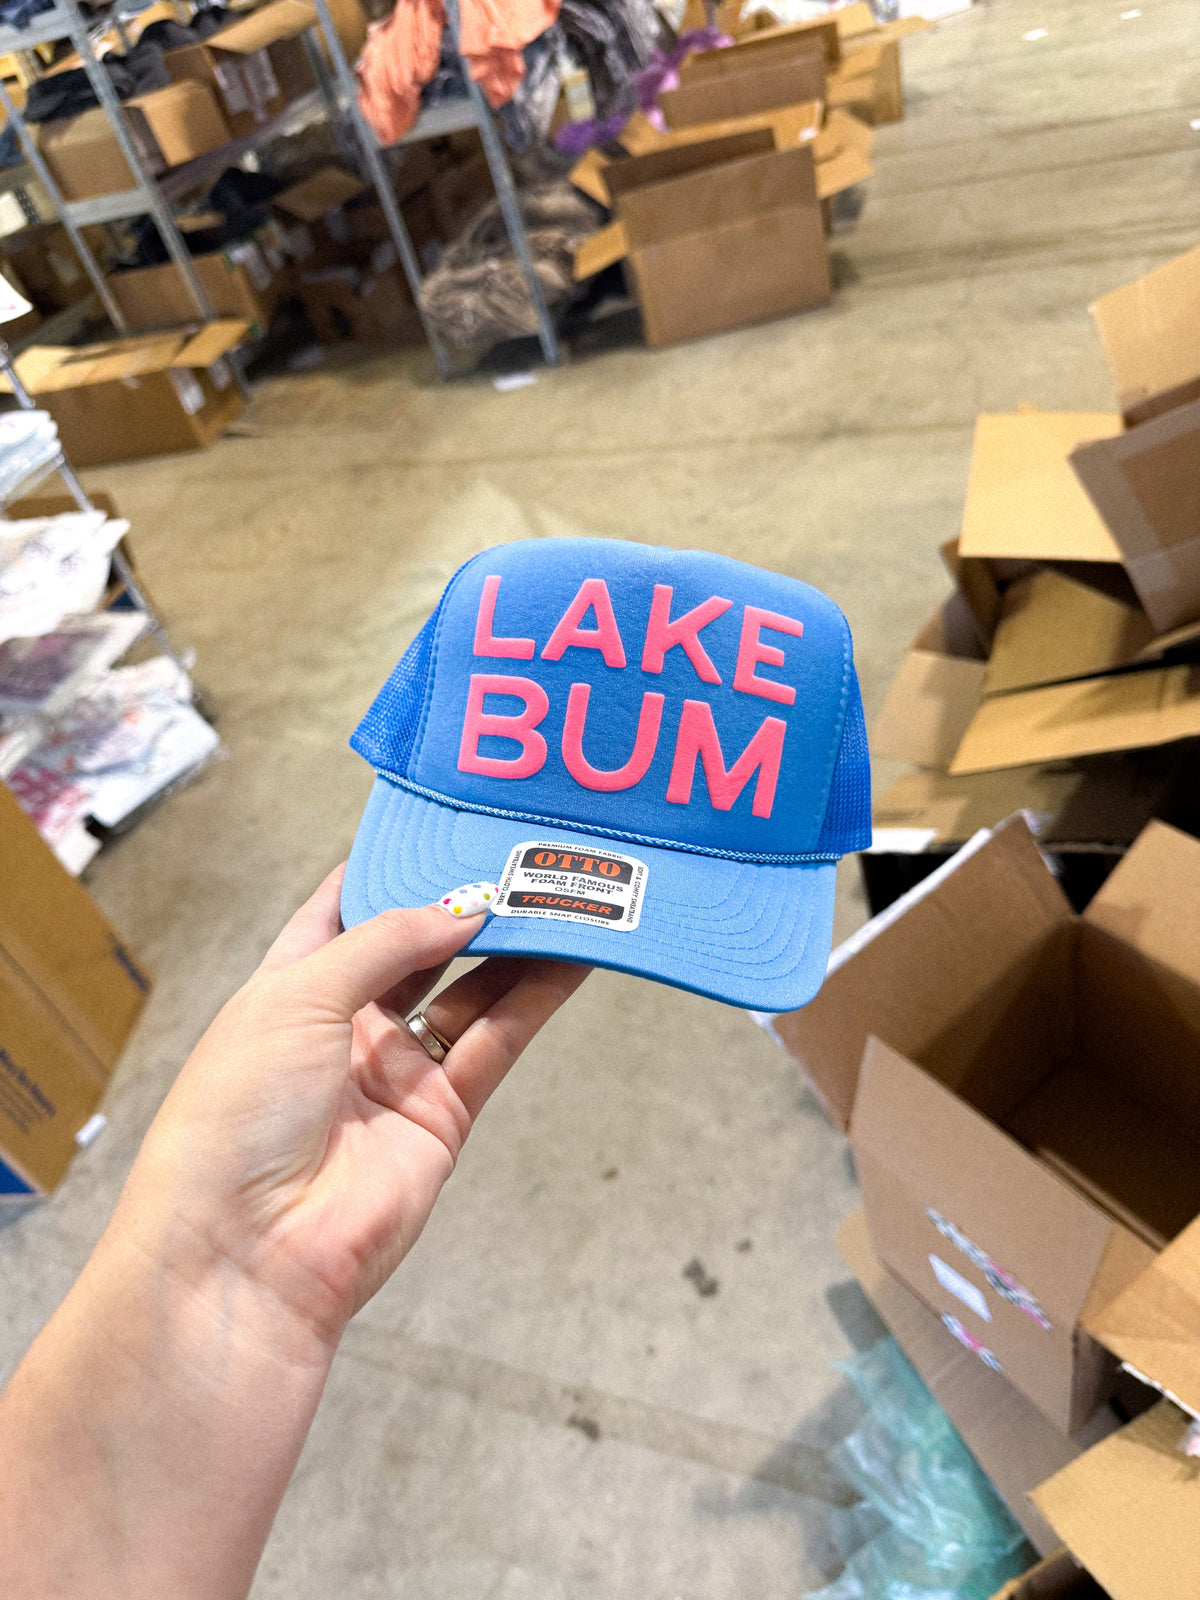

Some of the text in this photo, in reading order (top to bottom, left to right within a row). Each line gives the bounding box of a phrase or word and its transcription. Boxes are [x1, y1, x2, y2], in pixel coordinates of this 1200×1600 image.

[473, 575, 803, 705] LAKE
[457, 673, 787, 819] BUM
[538, 842, 624, 860] PREMIUM FOAM FABRIC
[534, 851, 621, 877] OTTO
[523, 871, 624, 892] WORLD FAMOUS
[531, 878, 614, 894] FOAM FRONT
[554, 886, 586, 896] OSFM
[522, 895, 613, 915] TRUCKER
[574, 914, 610, 925] CLOSURE
